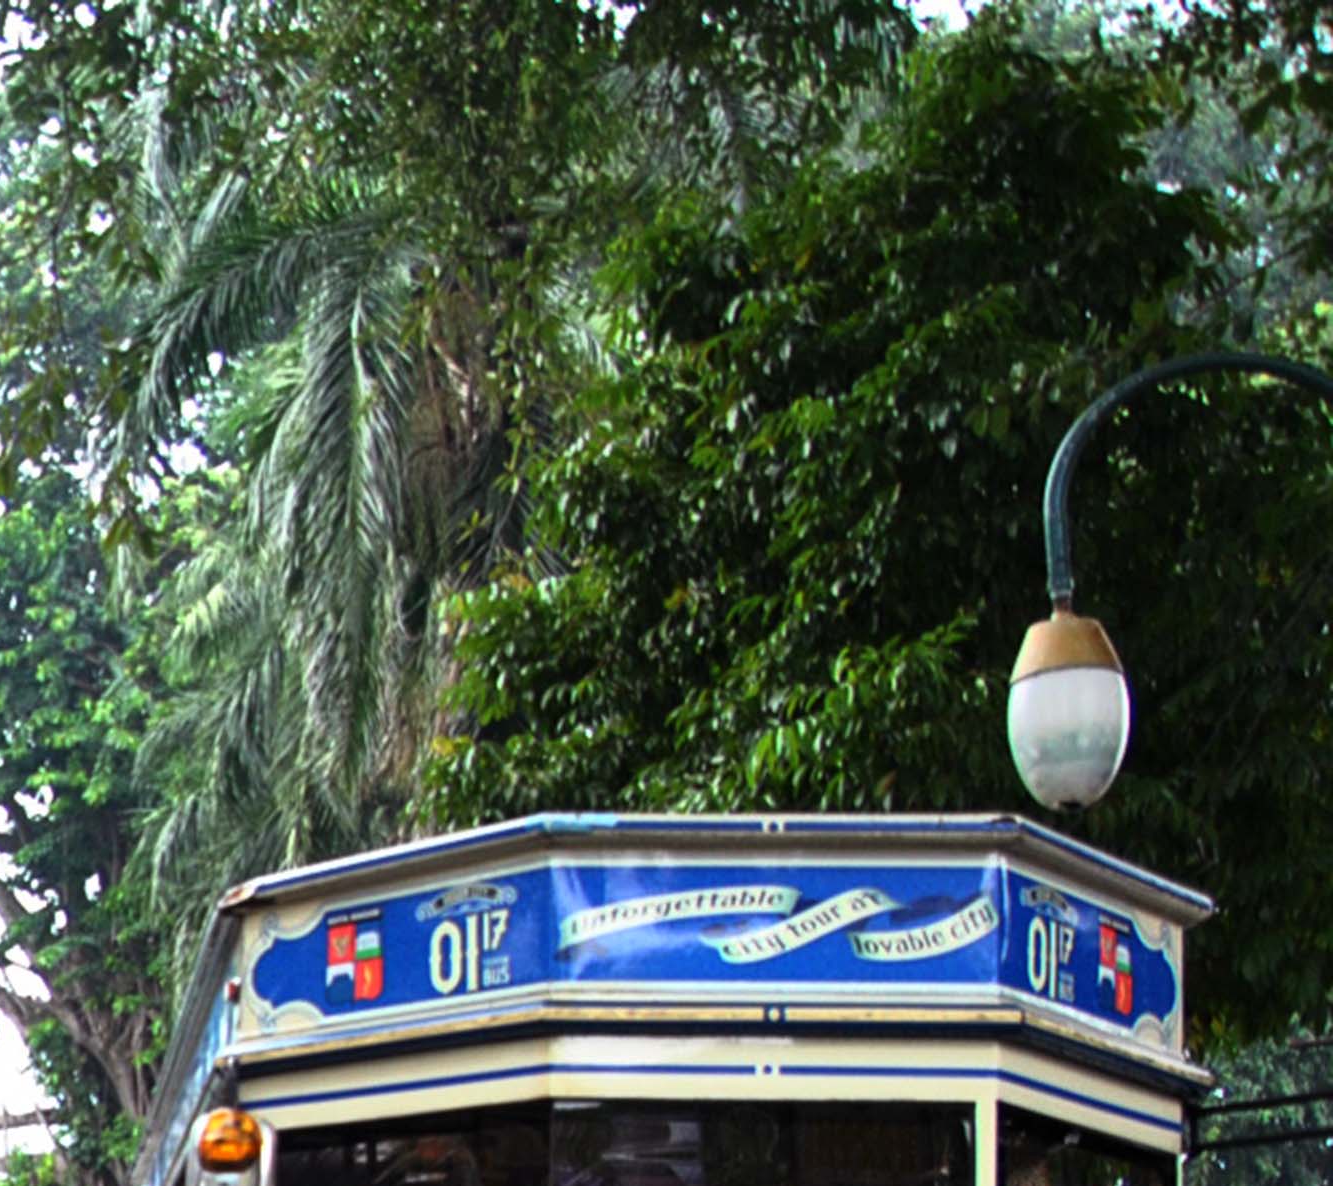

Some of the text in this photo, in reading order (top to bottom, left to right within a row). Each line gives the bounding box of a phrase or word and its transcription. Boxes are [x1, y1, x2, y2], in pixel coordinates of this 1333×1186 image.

[571, 886, 785, 936] Unforgettable
[722, 890, 883, 958] city tour at
[854, 900, 994, 955] lovable city
